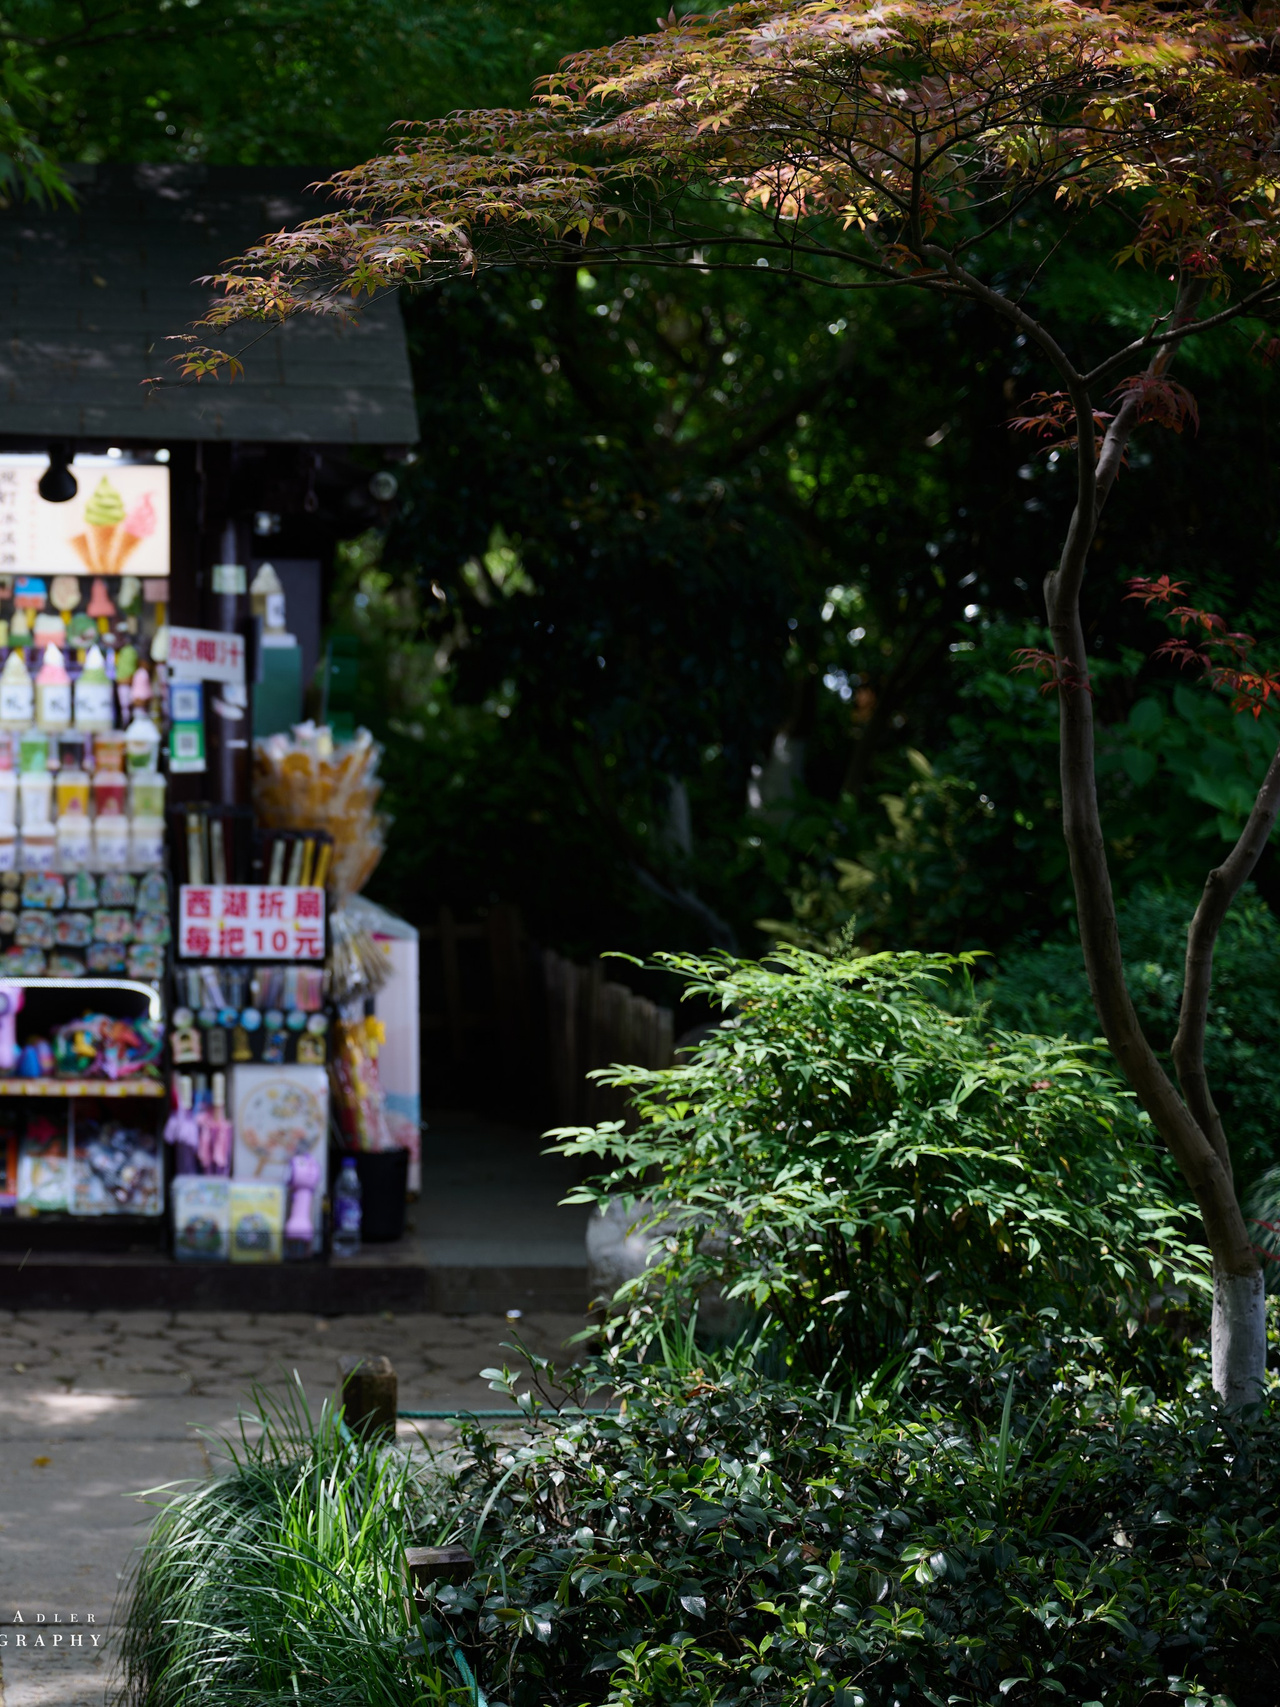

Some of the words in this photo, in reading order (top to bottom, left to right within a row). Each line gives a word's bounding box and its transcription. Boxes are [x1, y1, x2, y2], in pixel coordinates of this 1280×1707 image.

[170, 635, 243, 668] 热椰汁
[186, 890, 320, 919] 西湖折扇
[186, 926, 320, 957] 每把10元
